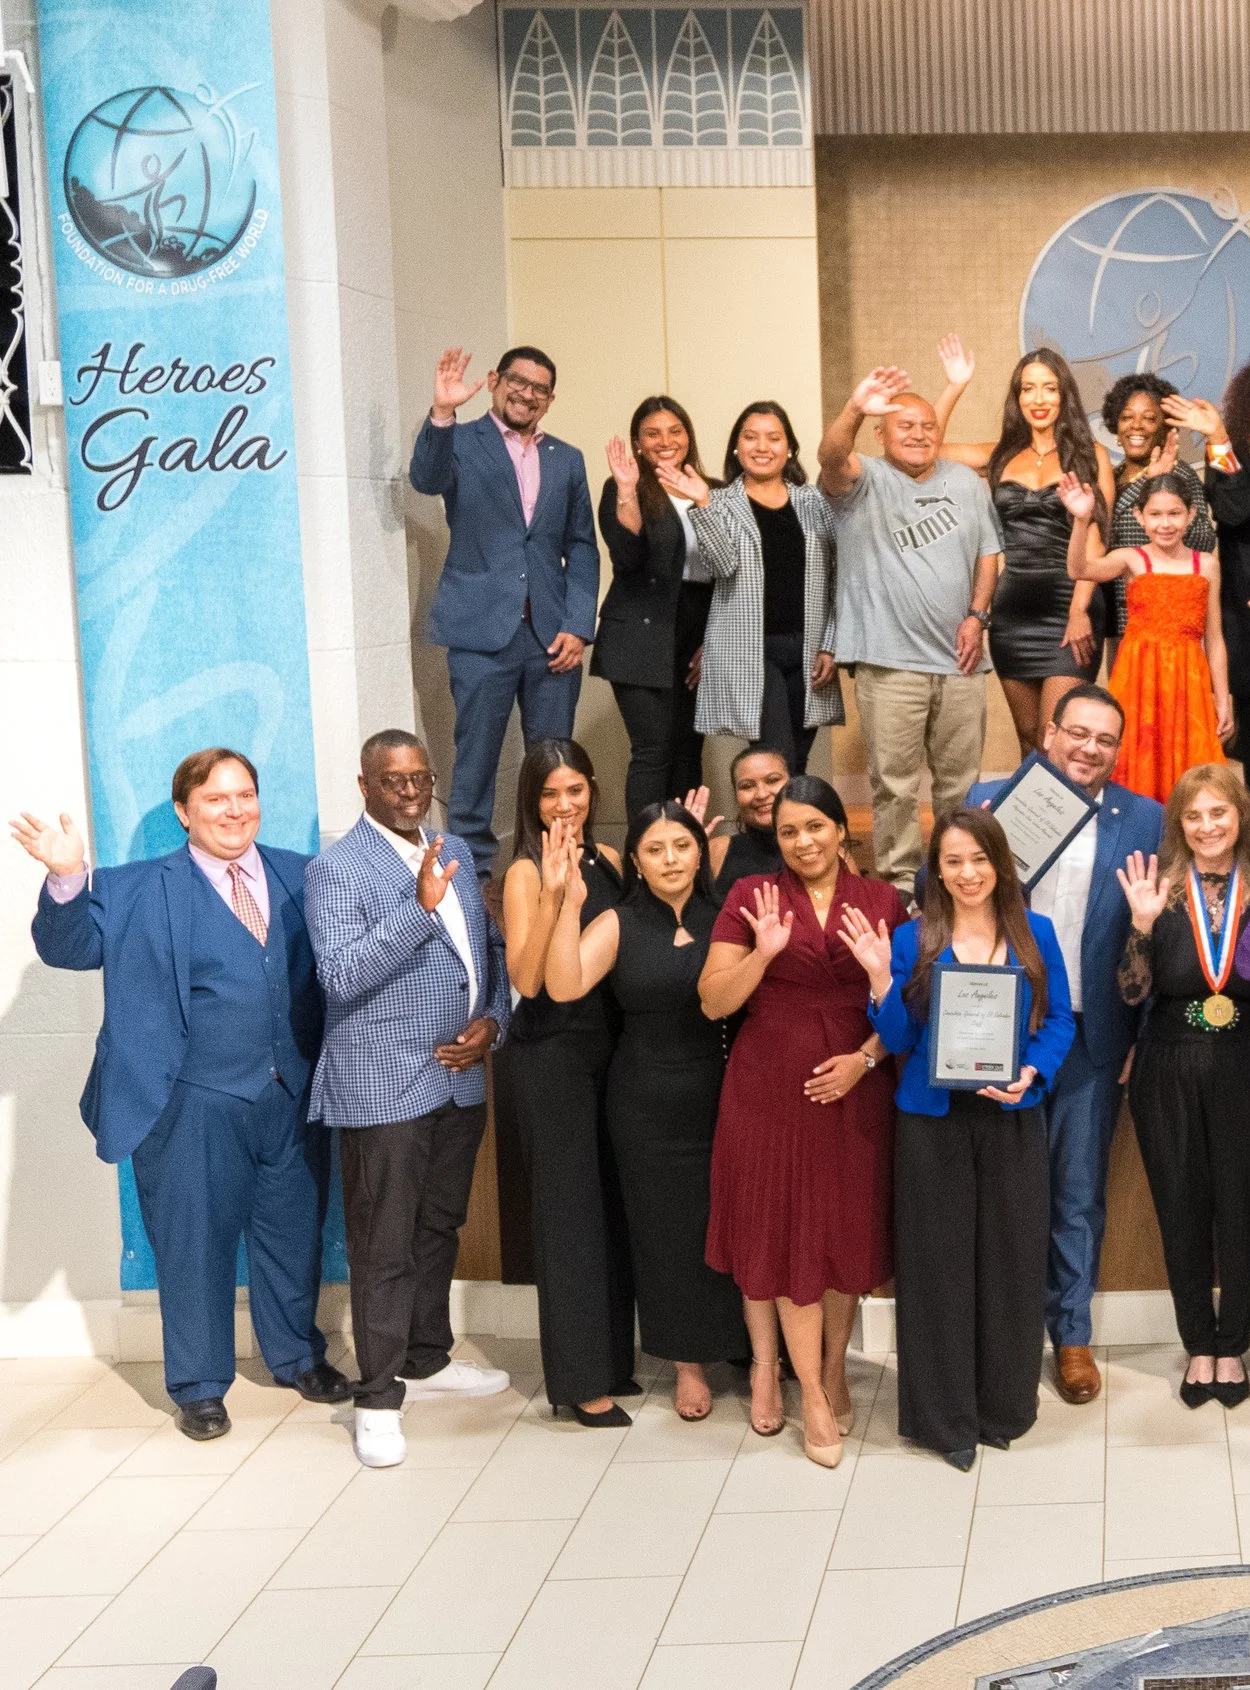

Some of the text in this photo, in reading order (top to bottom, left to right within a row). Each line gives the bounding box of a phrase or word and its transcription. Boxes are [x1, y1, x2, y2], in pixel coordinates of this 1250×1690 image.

[57, 208, 269, 296] FOUNDATION FOR A DRUG-FREE WORLD
[69, 342, 276, 406] Heroes
[81, 404, 288, 512] Gala
